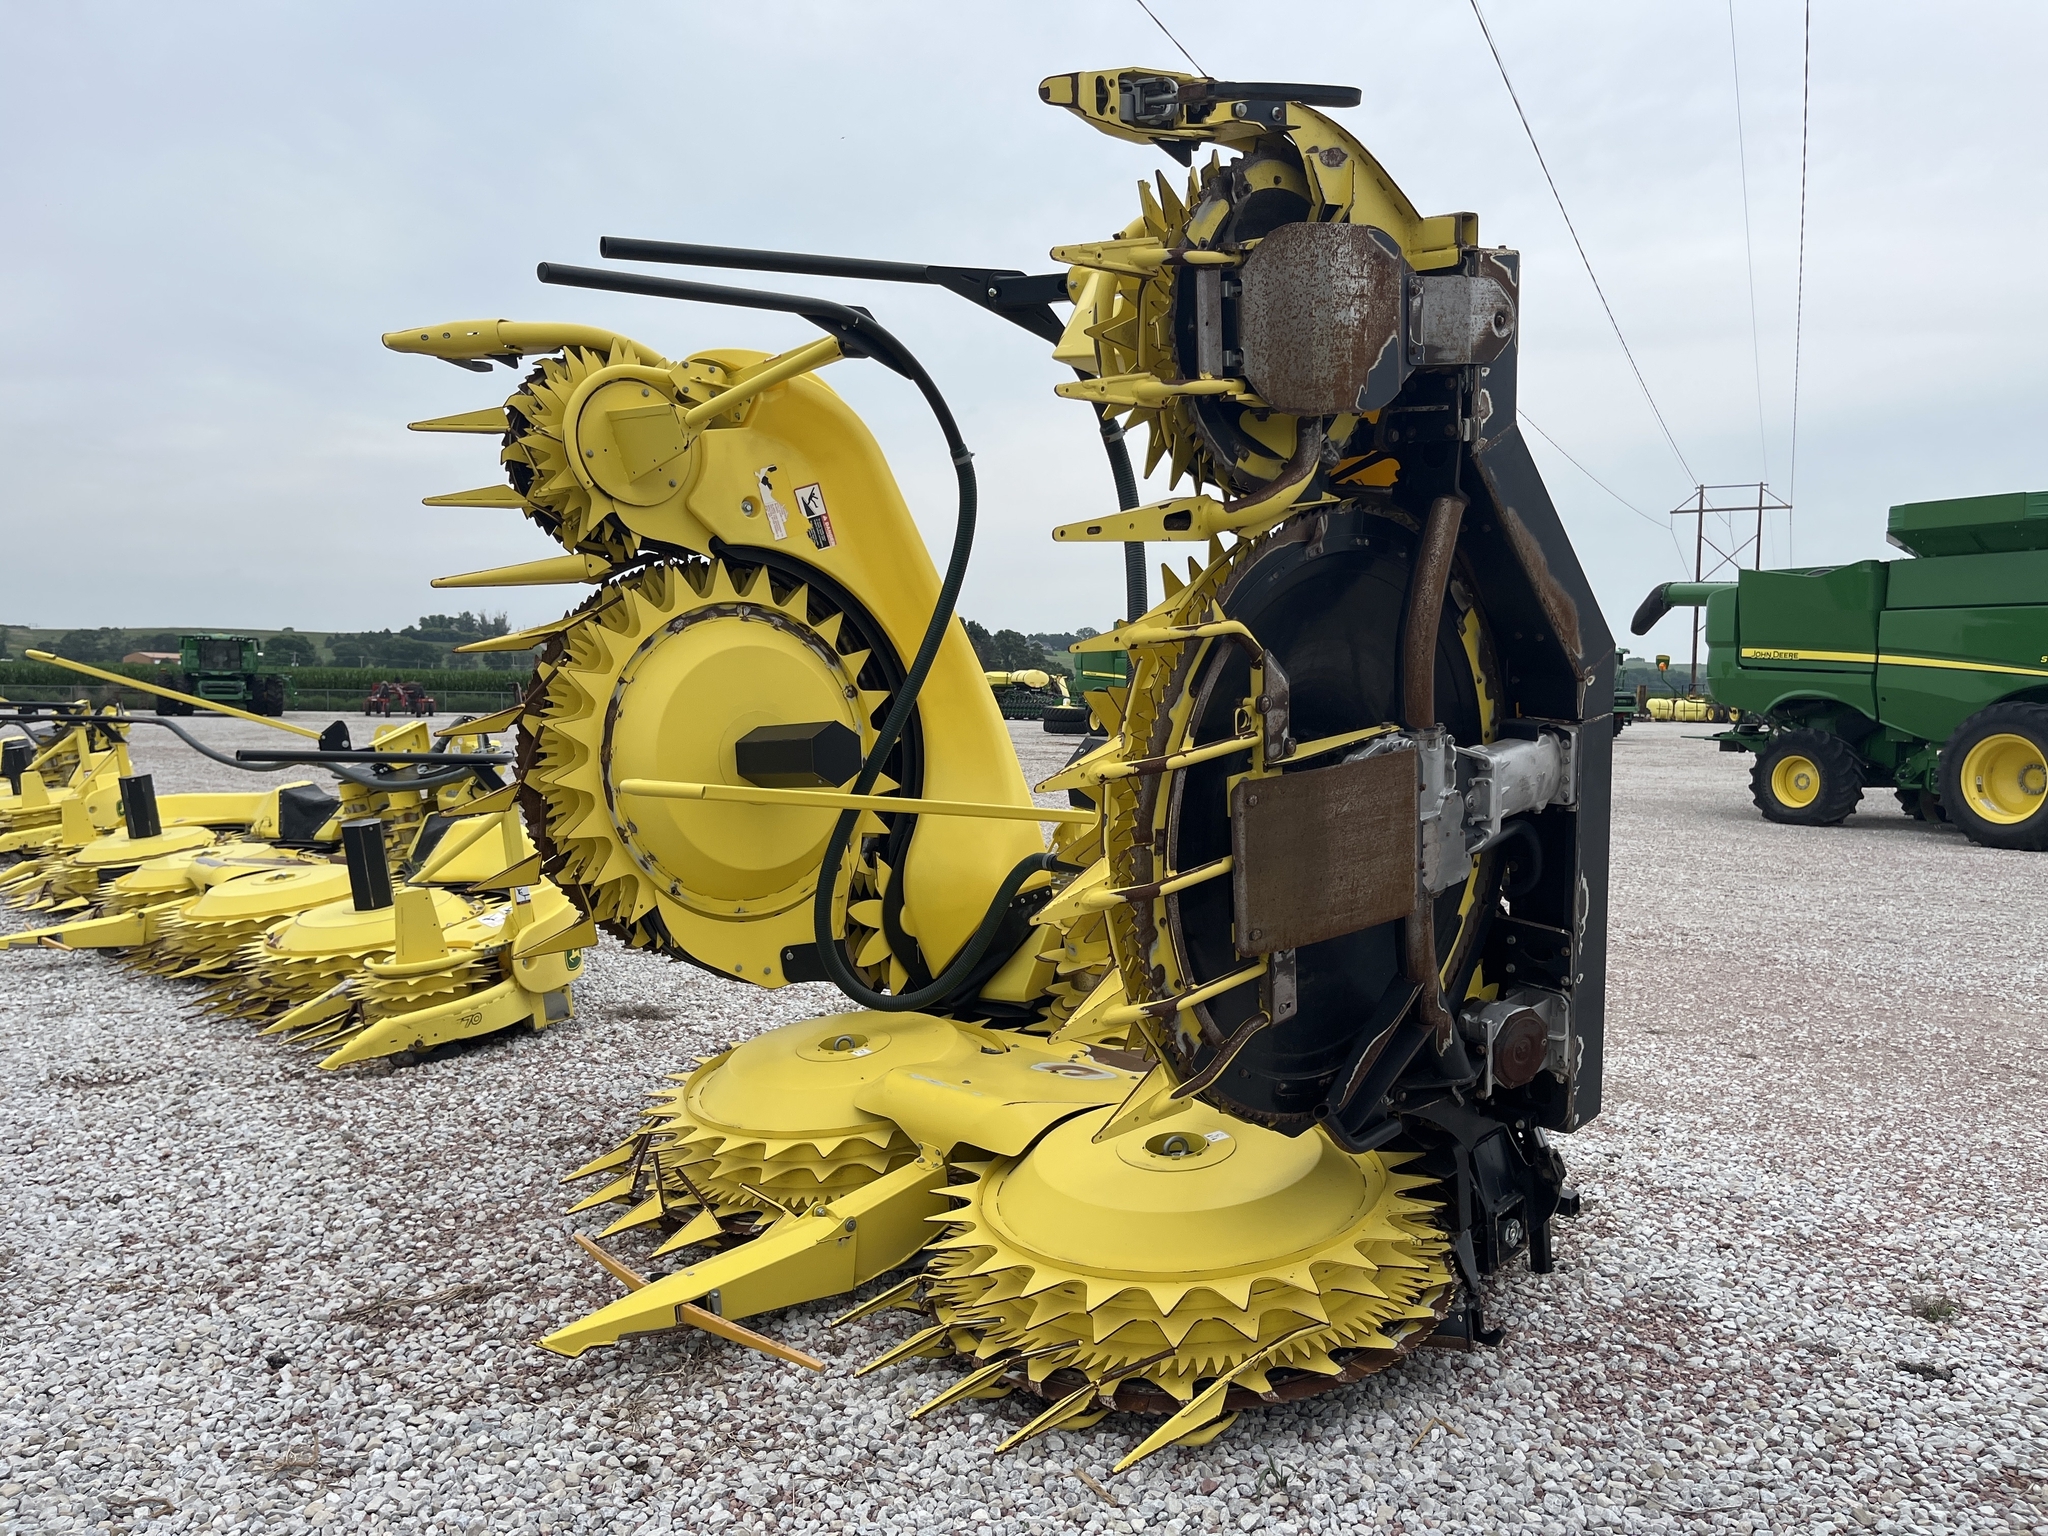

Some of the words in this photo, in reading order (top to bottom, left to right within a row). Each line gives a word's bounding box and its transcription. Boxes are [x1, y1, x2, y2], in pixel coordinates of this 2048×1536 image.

[824, 521, 837, 546] DANGER
[1751, 650, 1772, 658] JOHN
[1773, 651, 1799, 659] DEERE
